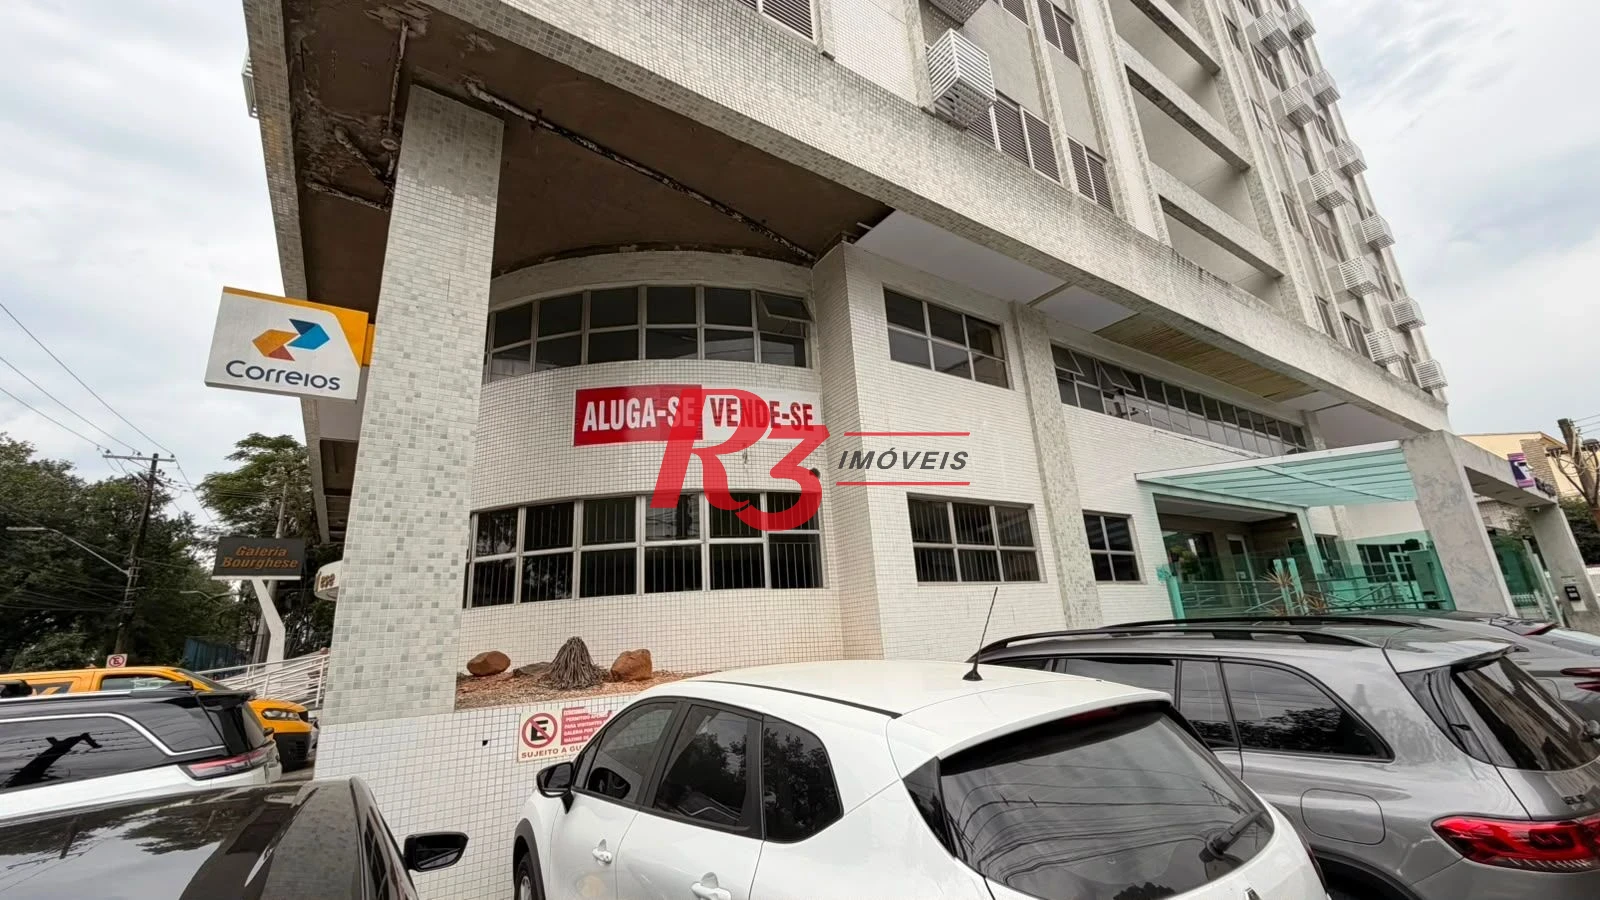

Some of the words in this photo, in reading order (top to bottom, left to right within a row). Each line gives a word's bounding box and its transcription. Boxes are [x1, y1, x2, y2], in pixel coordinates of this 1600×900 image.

[225, 359, 341, 391] Correios
[582, 396, 696, 432] ALUGA-SE
[710, 397, 814, 432] VENDE-SE
[235, 545, 288, 558] Galeria
[222, 556, 299, 570] Bourghese
[521, 748, 559, 759] SUJEITO
